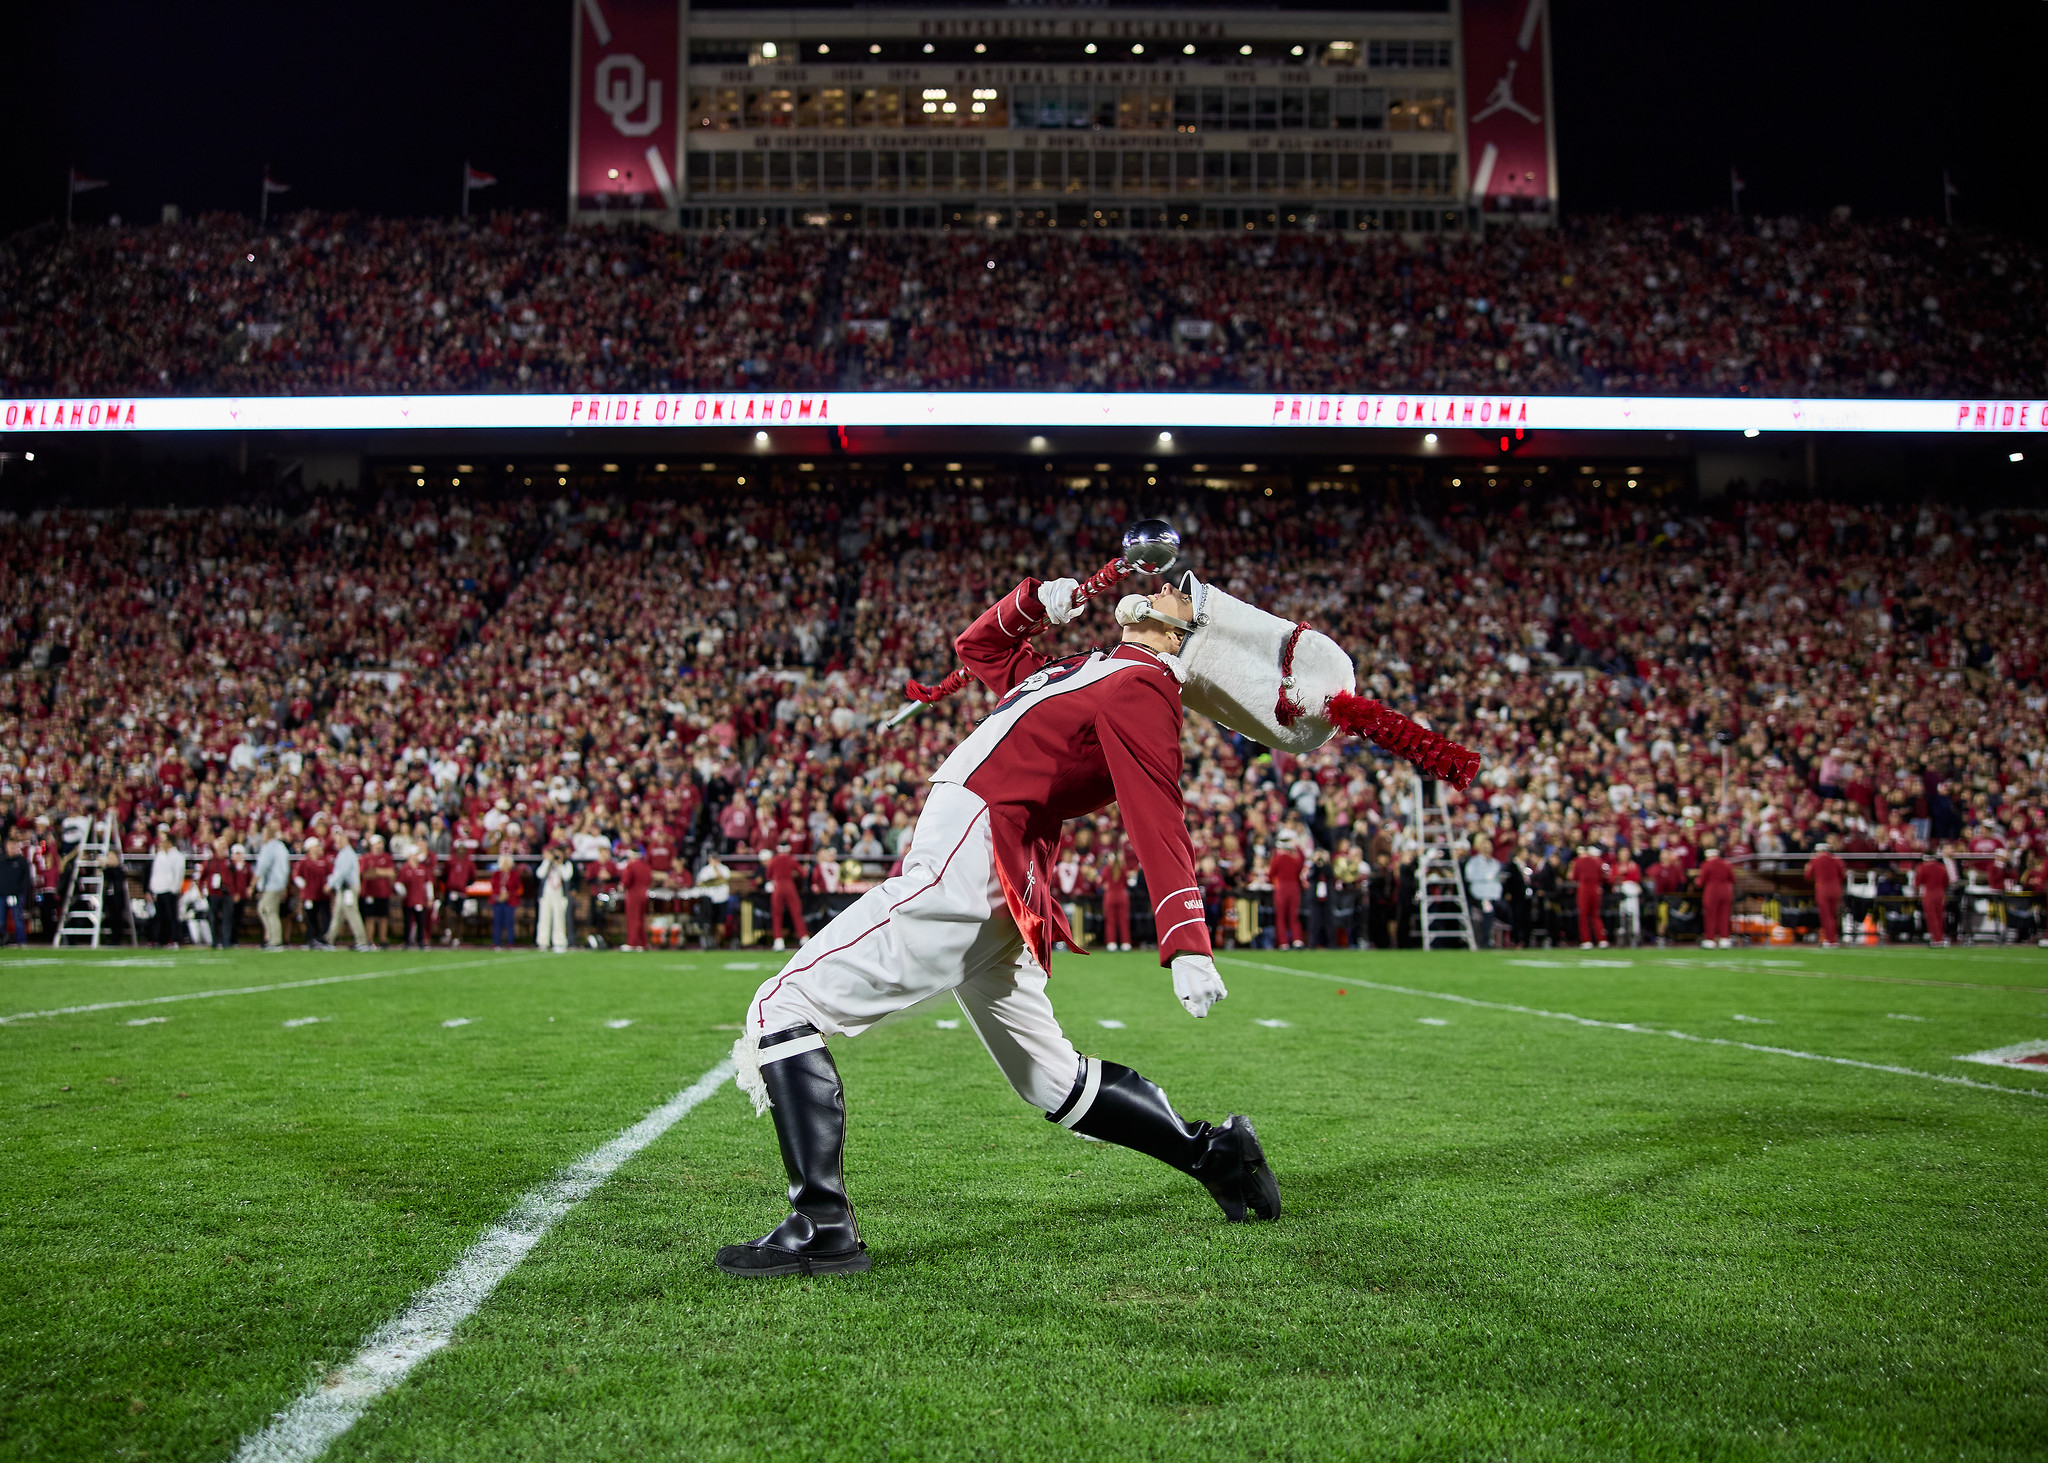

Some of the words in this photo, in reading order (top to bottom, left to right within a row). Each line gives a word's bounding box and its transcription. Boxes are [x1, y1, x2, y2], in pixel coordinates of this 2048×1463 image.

[921, 21, 1056, 37] UNIVERSITY
[1070, 22, 1093, 37] OF
[1110, 22, 1226, 38] OKLAHOMA
[955, 69, 1057, 83] NATIONAL
[1068, 69, 1186, 83] CHAMPIONS
[594, 53, 664, 137] OU
[872, 135, 986, 147] CHAMPIONSHIPS
[1089, 136, 1204, 147] CHAMPIONSHIPS
[5, 404, 137, 427] OKLAHOMA
[570, 400, 643, 421] PRIDE
[655, 400, 682, 421] OF
[694, 399, 828, 420] OKLAHOMA
[1272, 400, 1344, 421] PRIDE
[1357, 401, 1383, 421] OF
[1396, 401, 1527, 422] OKLAHOMA
[1956, 406, 2029, 426] PRIDE
